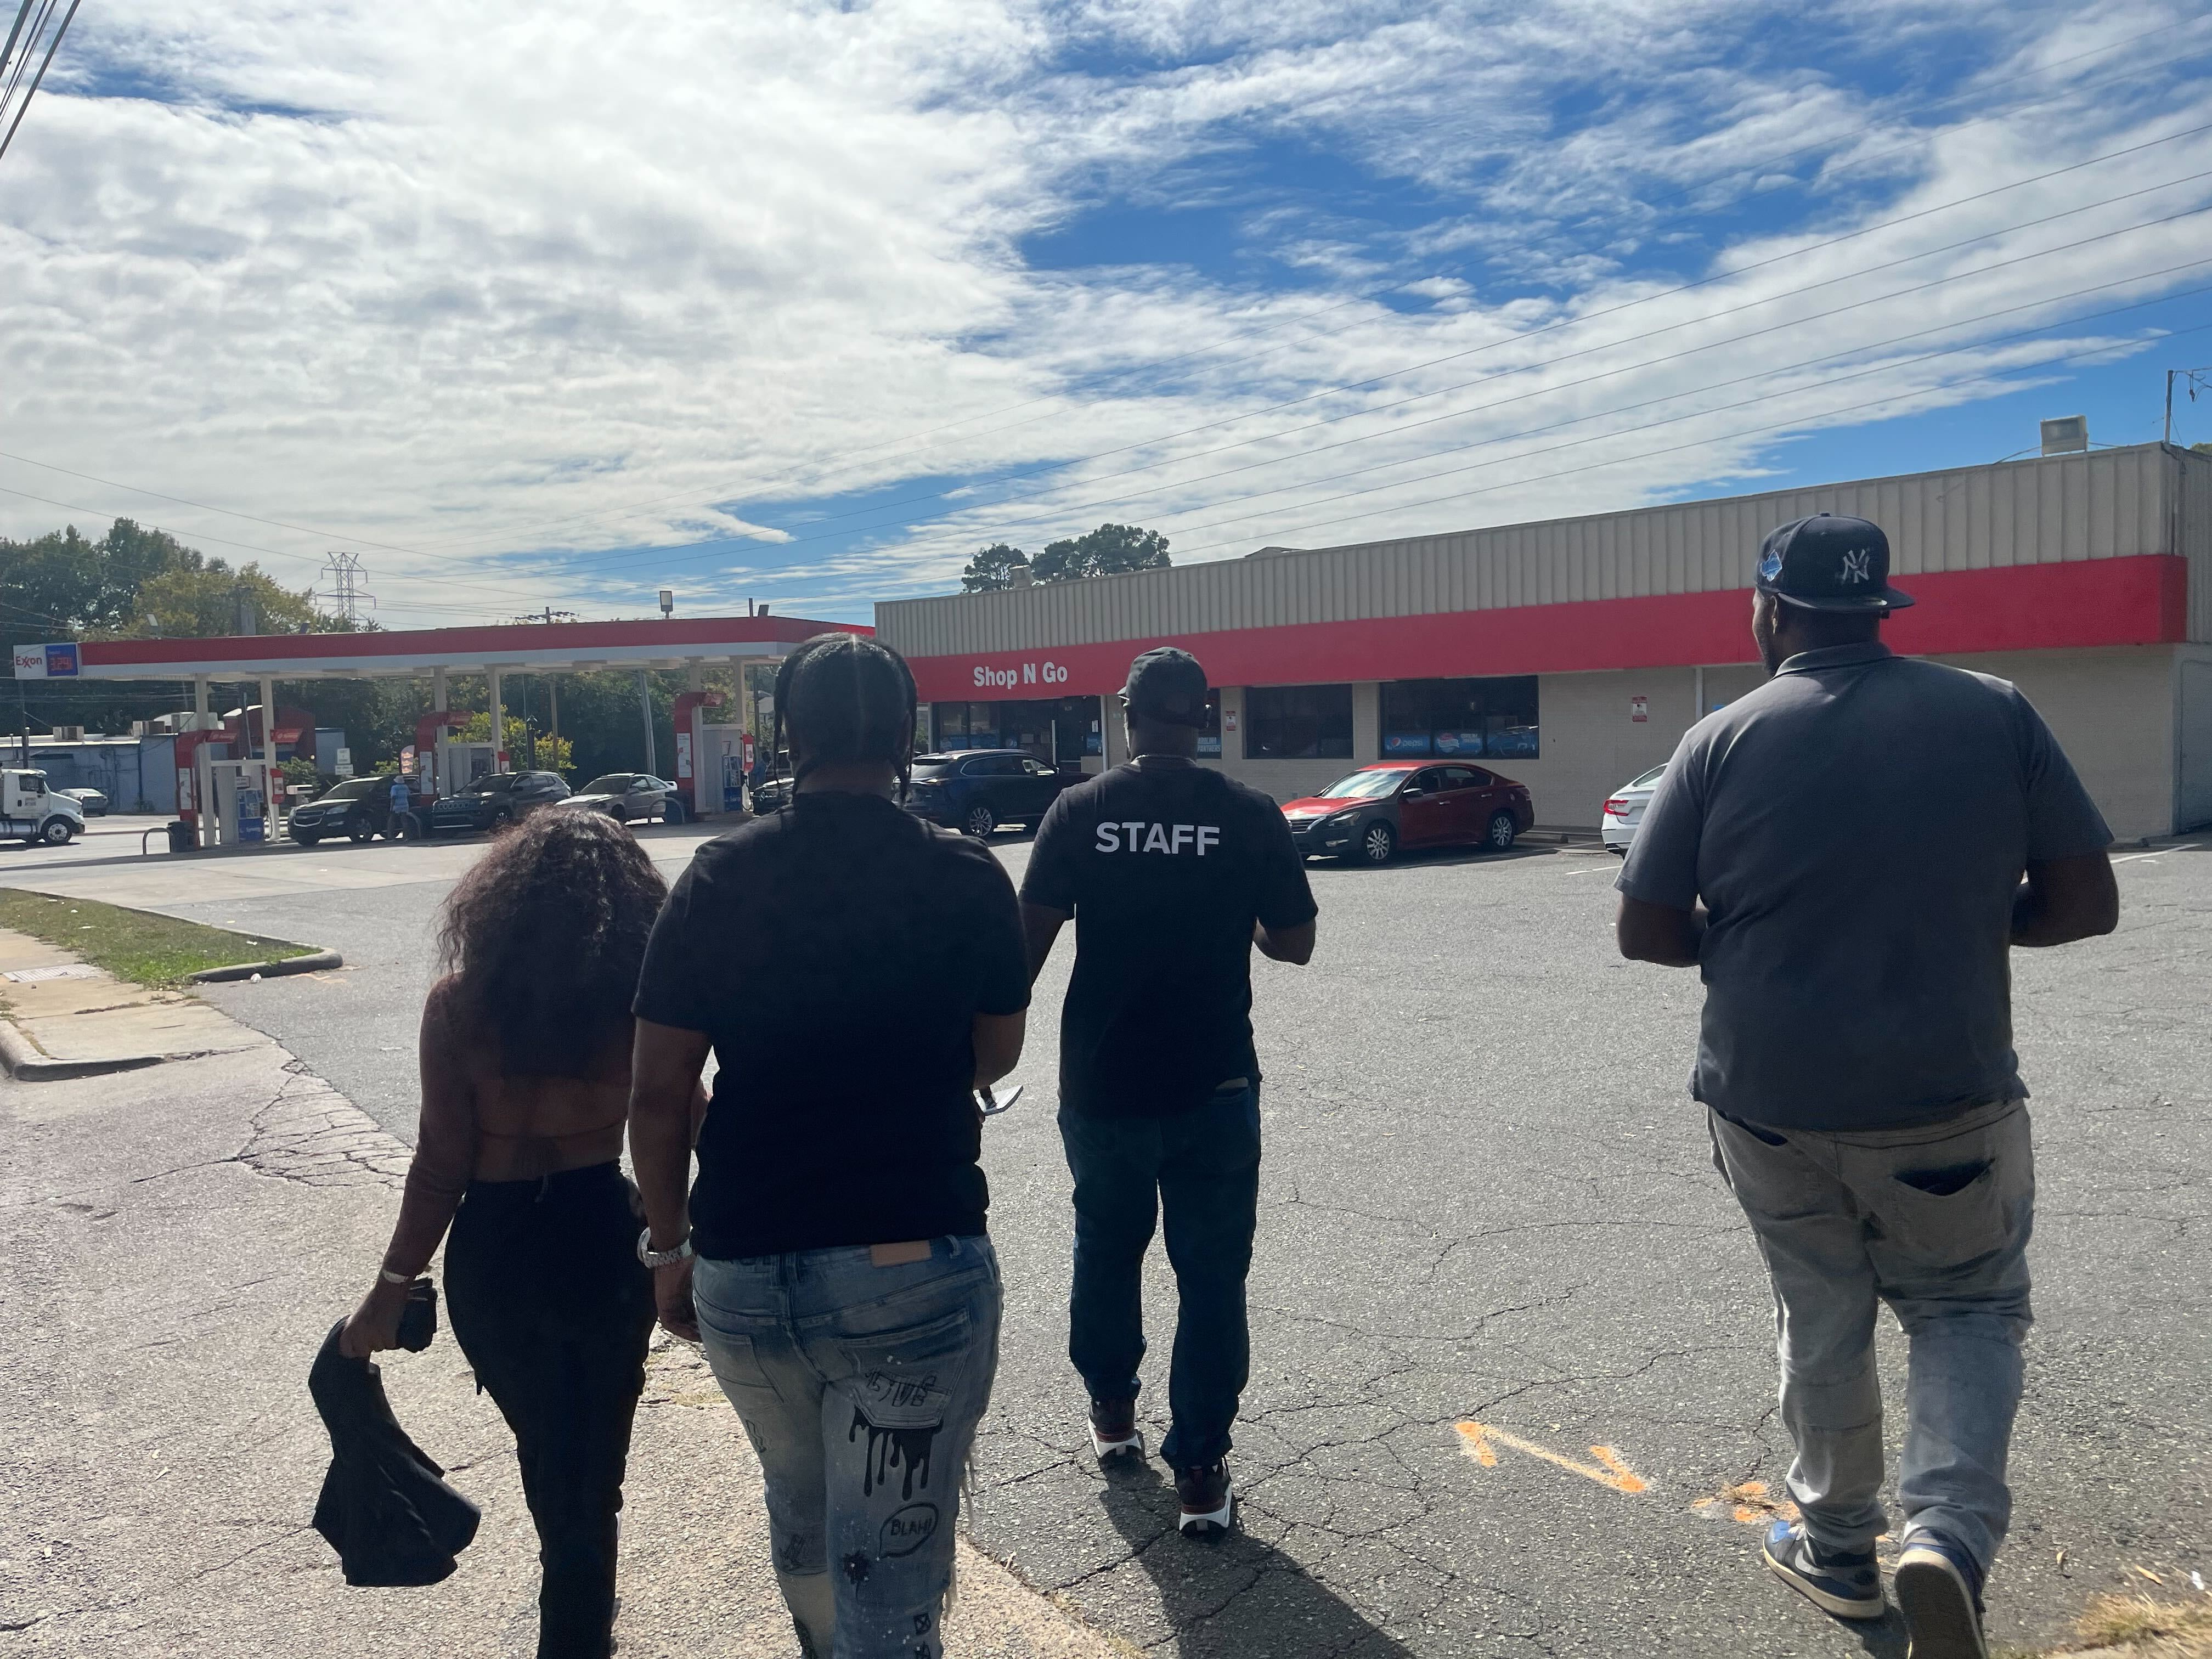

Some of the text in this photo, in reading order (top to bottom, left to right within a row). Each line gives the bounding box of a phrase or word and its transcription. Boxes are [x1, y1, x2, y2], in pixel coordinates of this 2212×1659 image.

[1843, 549, 1870, 583] NY
[15, 656, 42, 668] Exxon
[974, 662, 1068, 690] Shop N Go
[1402, 738, 1423, 748] pepsi
[1095, 822, 1220, 856] STAFF
